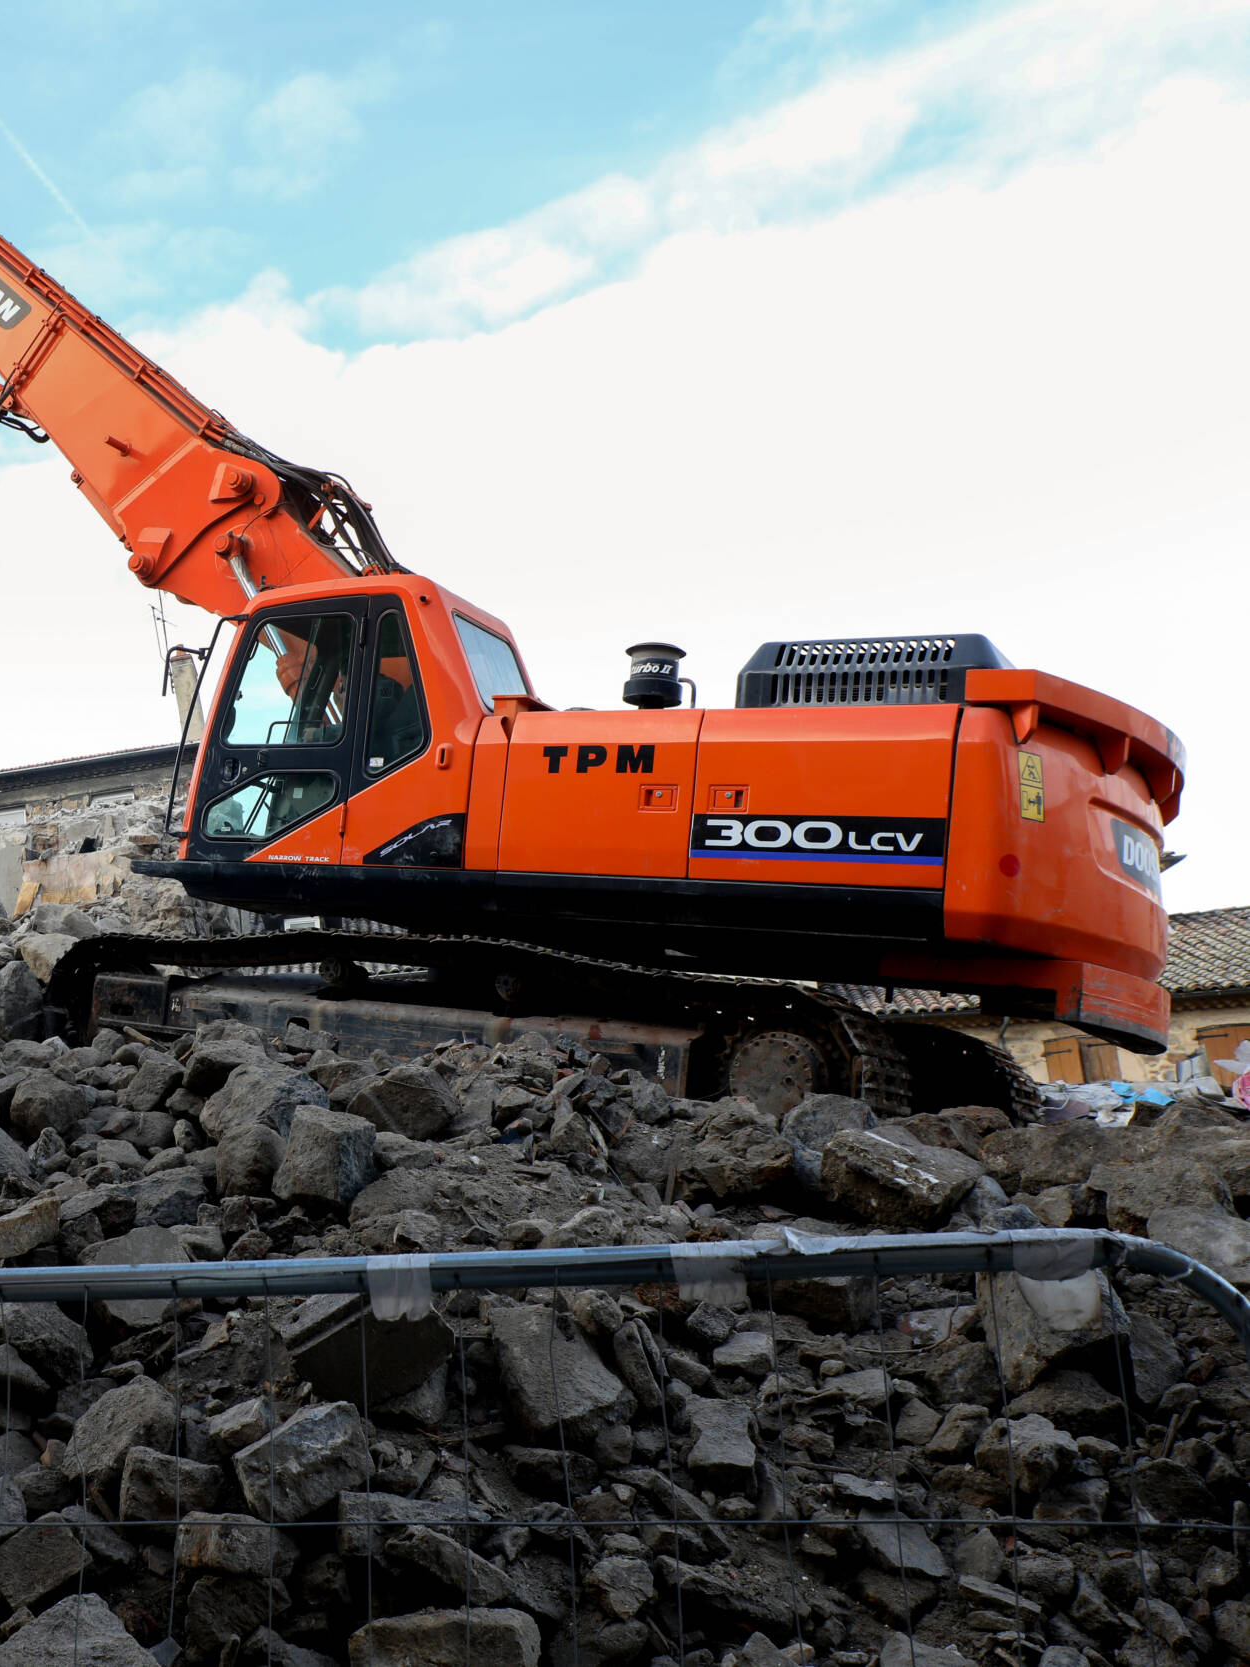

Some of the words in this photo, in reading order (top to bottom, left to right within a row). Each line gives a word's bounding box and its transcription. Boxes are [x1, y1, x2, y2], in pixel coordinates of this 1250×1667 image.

[543, 744, 655, 774] TPM
[705, 819, 843, 850] 300
[848, 831, 924, 852] LCV
